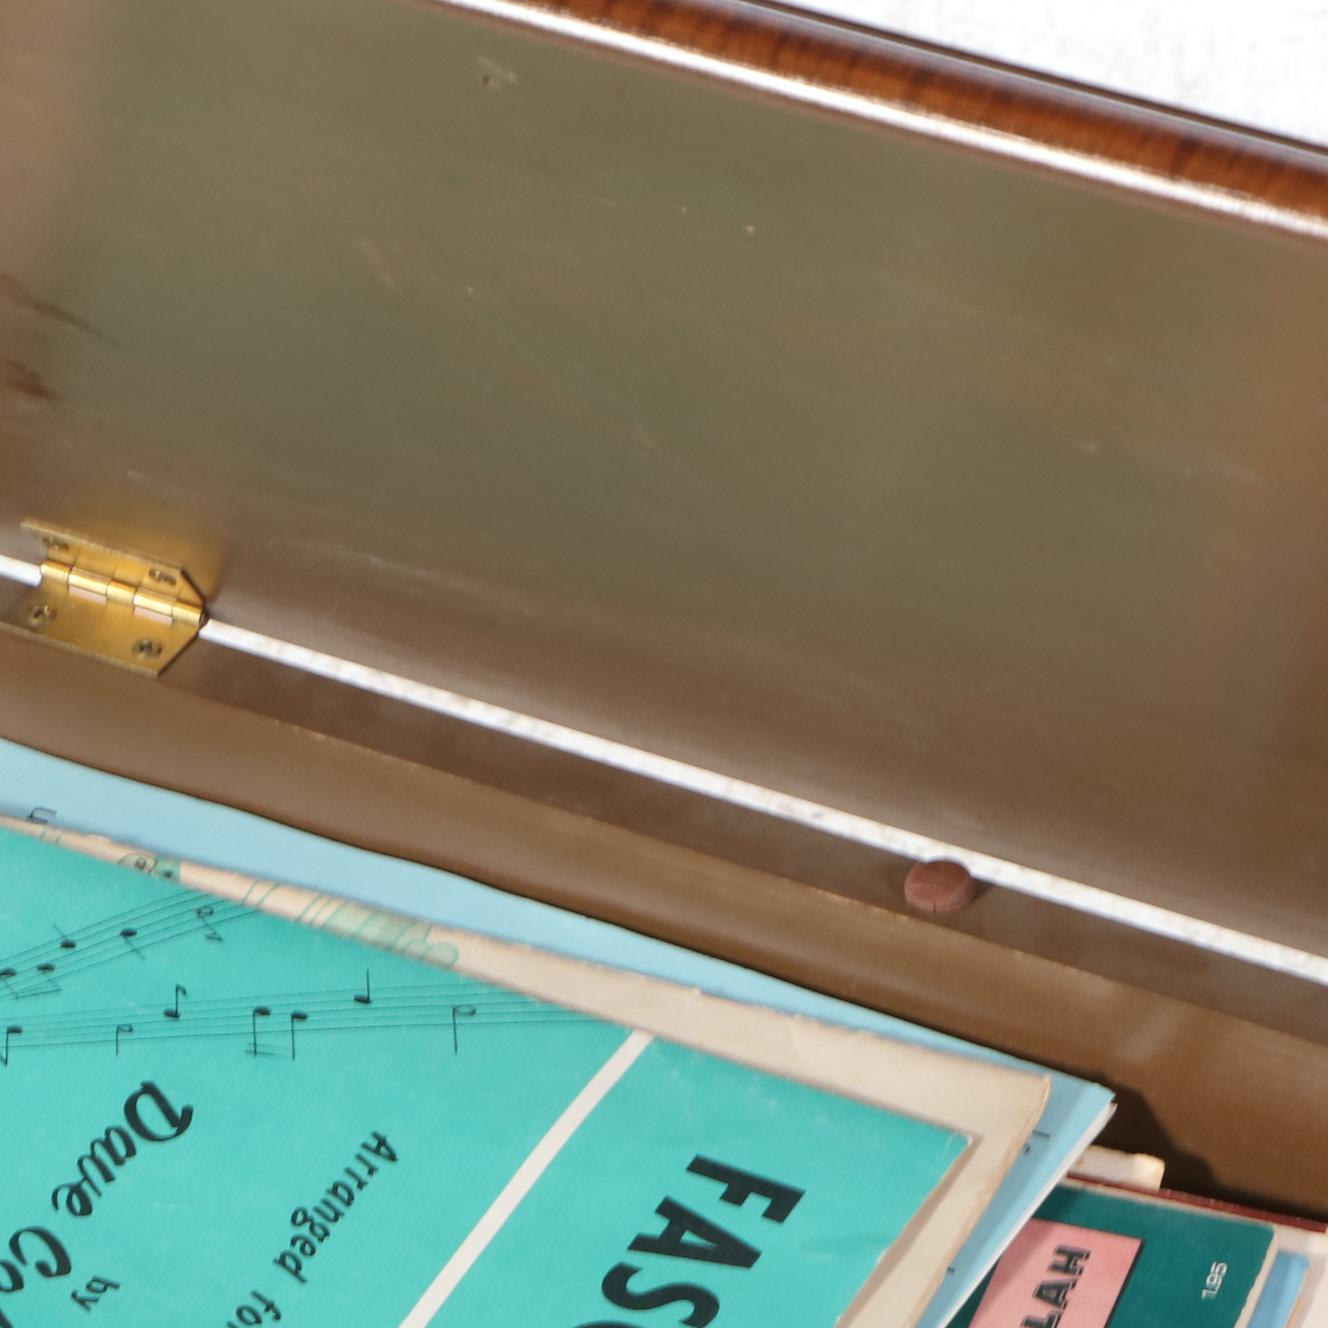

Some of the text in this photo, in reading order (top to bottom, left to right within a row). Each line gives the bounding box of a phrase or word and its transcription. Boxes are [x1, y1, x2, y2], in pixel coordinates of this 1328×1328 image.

[51, 1081, 194, 1216] Dave
[273, 1130, 399, 1283] Arranged
[70, 1275, 121, 1311] by
